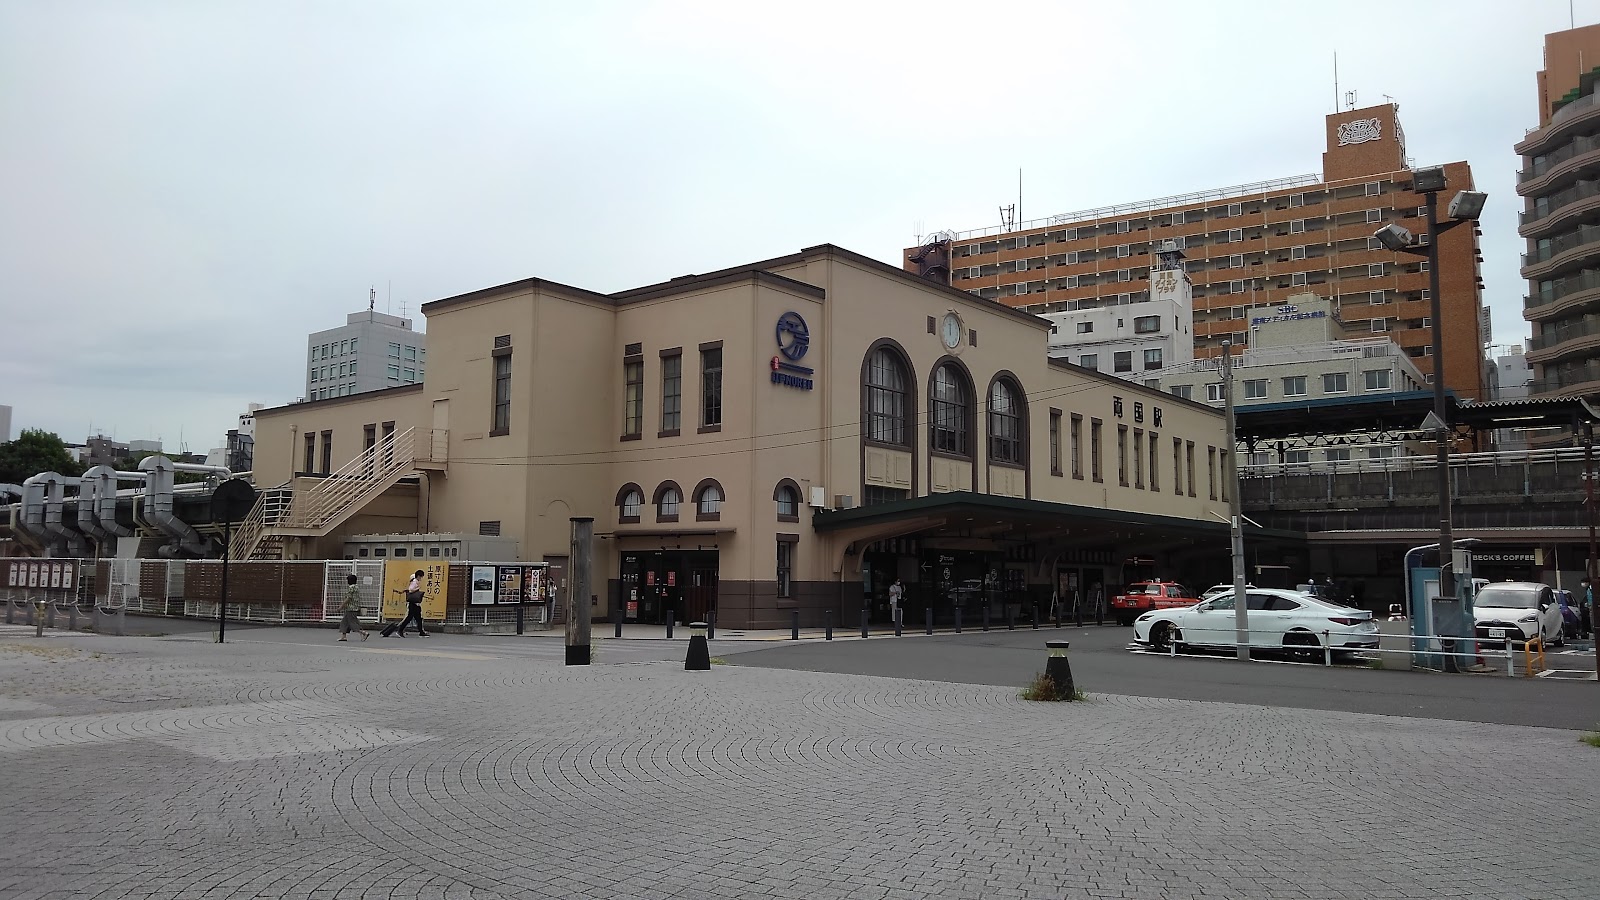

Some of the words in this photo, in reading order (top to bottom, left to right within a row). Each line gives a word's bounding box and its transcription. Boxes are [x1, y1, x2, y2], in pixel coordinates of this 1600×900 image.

[1113, 395, 1163, 428] 両国駅
[433, 565, 442, 595] 原寸大の
